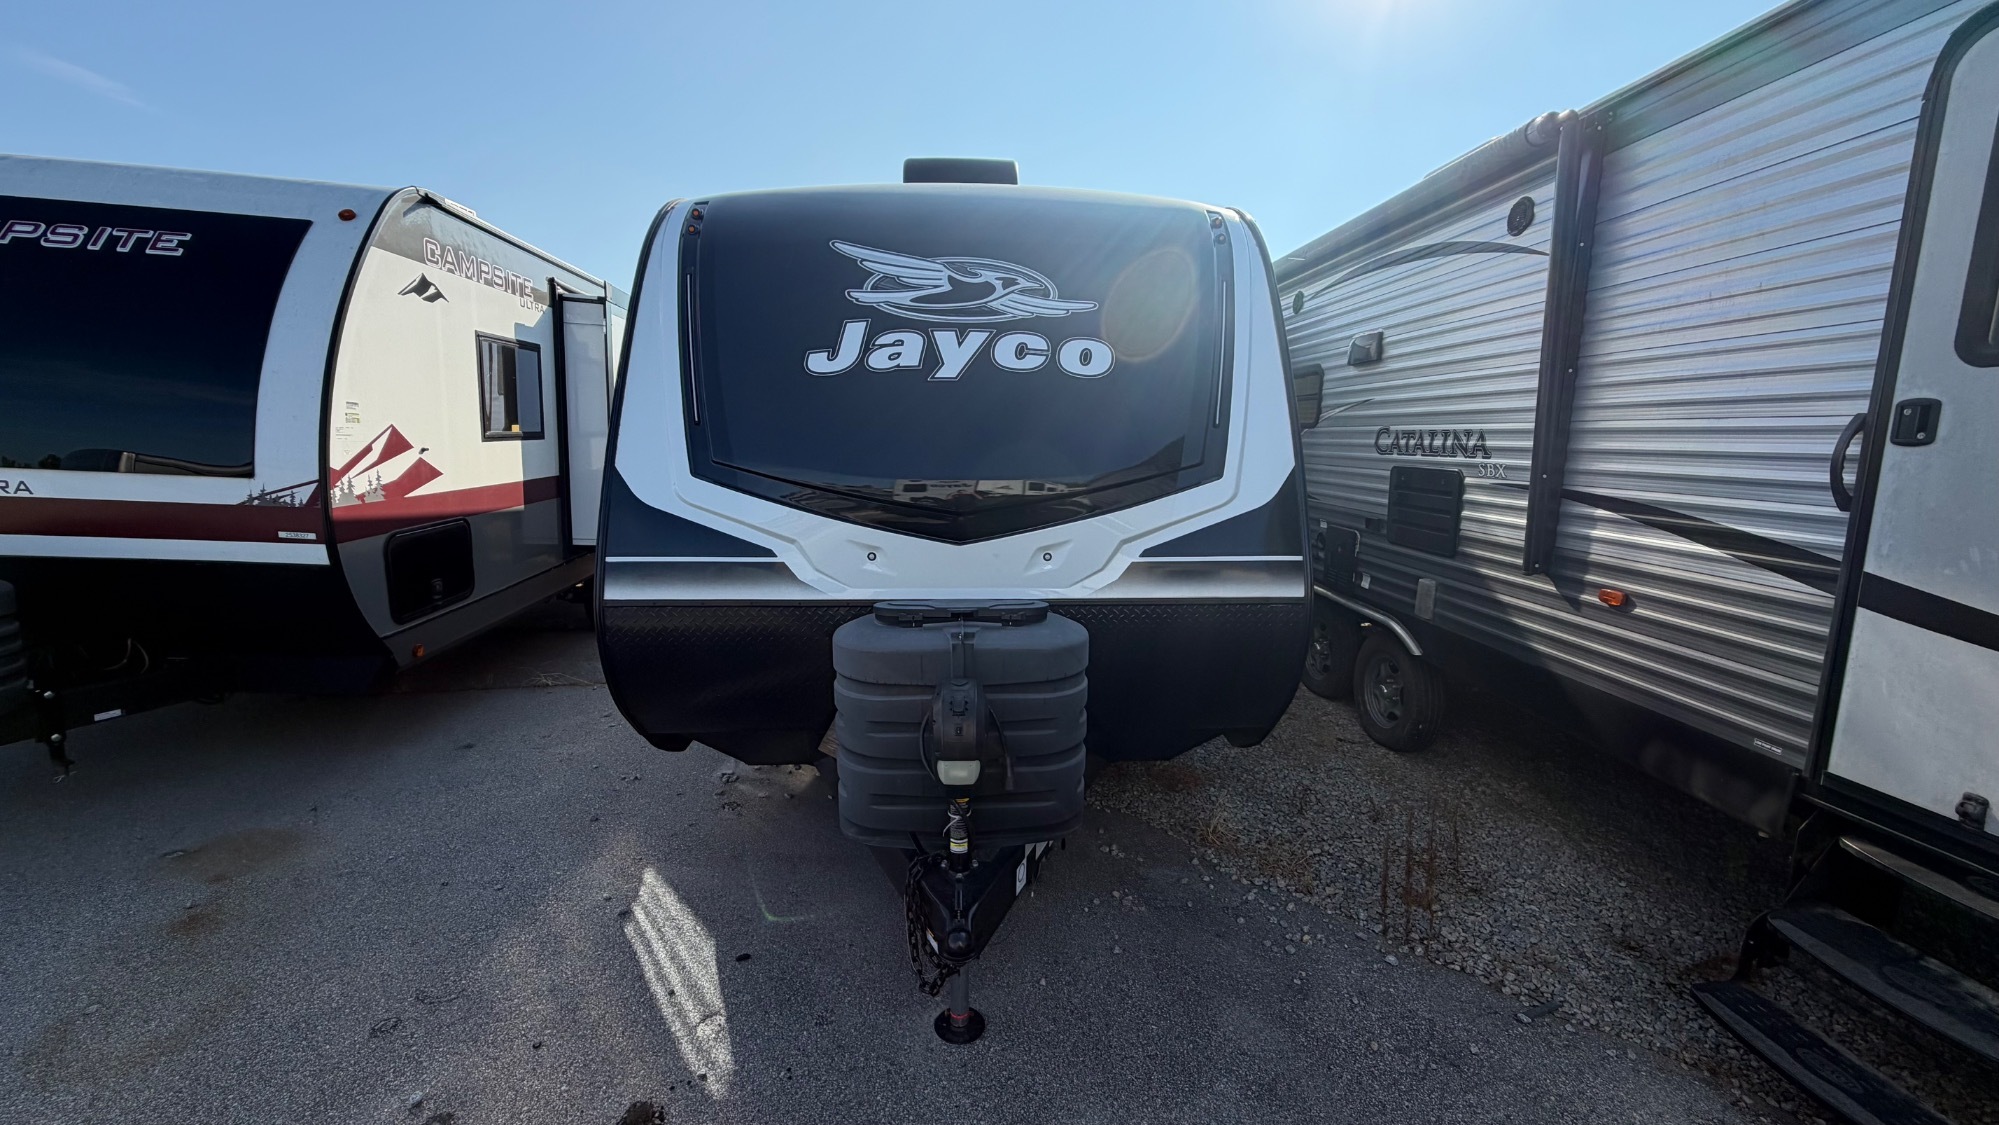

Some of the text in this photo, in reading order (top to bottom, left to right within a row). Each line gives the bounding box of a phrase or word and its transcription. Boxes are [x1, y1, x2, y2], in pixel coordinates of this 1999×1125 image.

[423, 237, 534, 301] CAMPSITE
[520, 297, 545, 314] ULTRA
[804, 319, 1115, 381] Jayco
[1374, 426, 1492, 459] CATALINA
[1478, 463, 1507, 478] SBX
